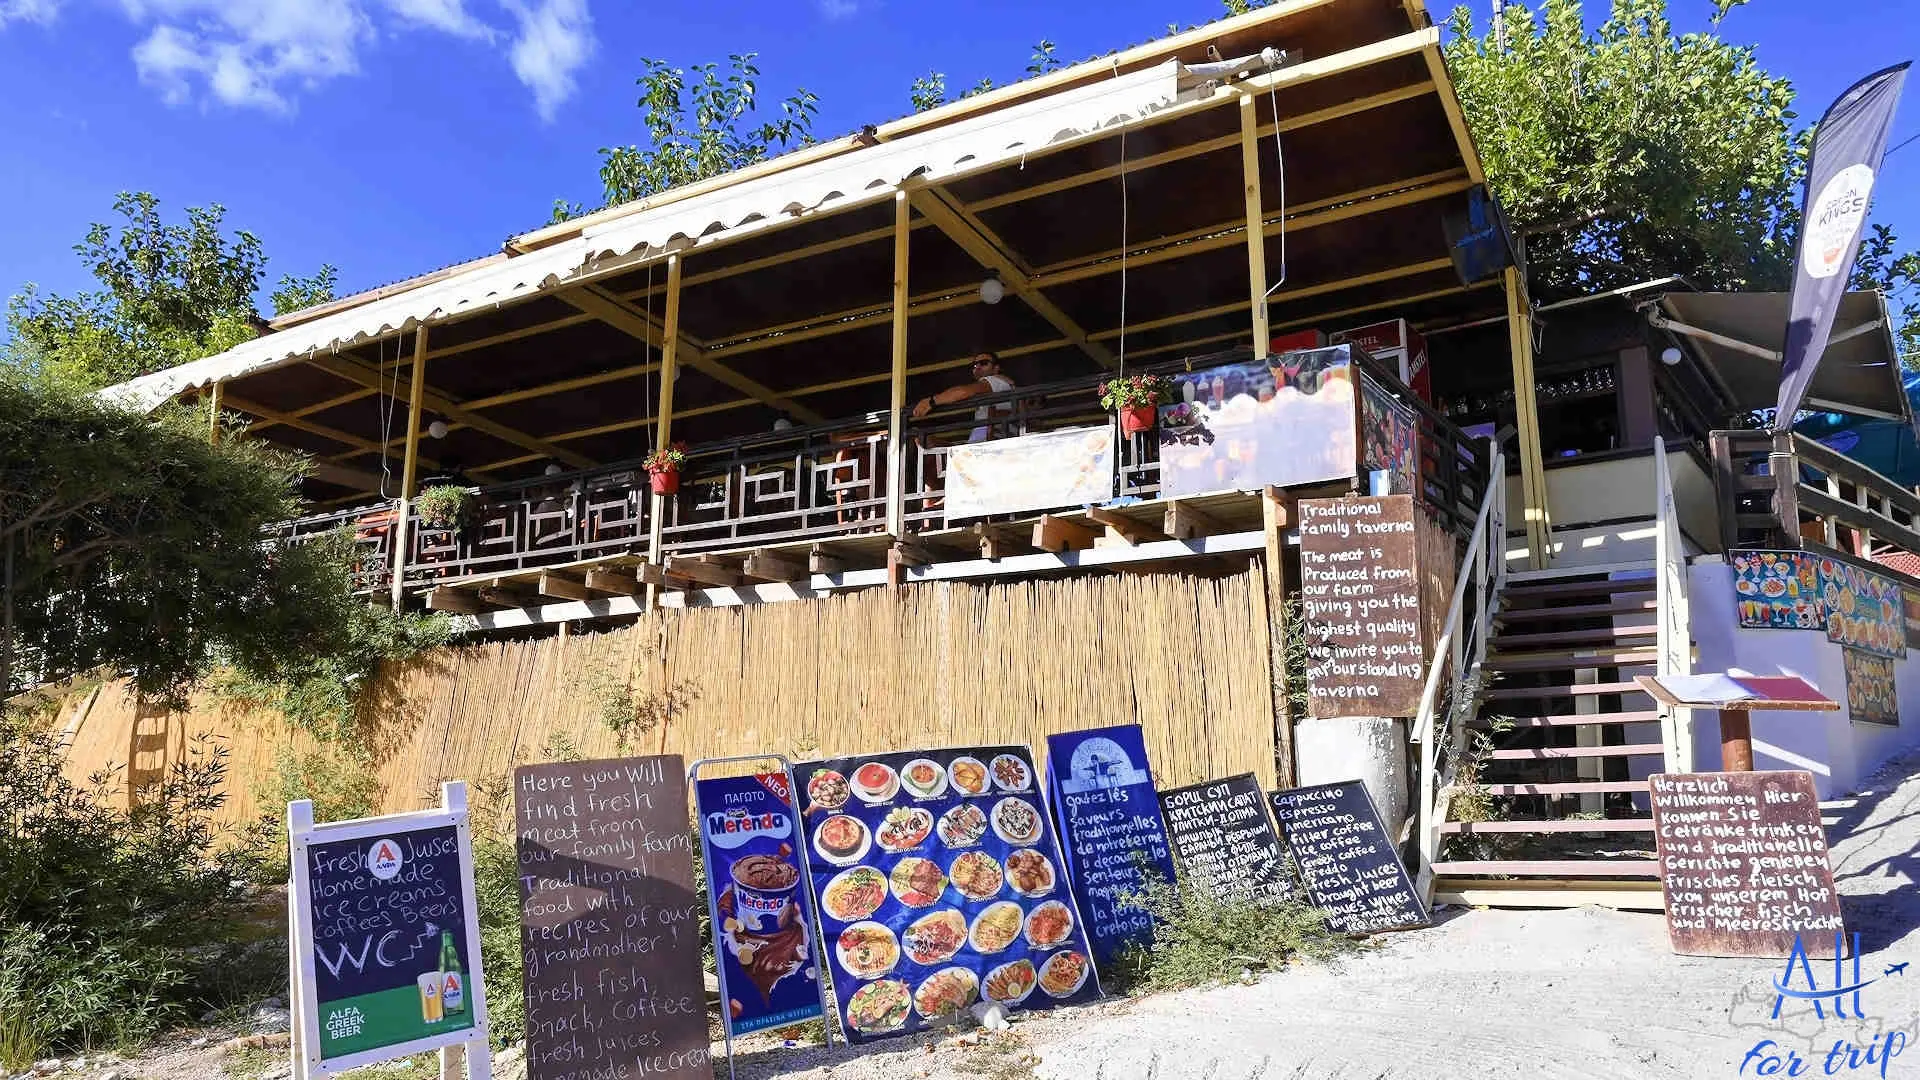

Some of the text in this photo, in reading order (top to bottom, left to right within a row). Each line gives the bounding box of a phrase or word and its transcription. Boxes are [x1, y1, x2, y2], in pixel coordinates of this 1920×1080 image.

[1302, 503, 1381, 516] Traditional
[1300, 519, 1414, 537] family taverna
[1302, 546, 1383, 562] The meat is
[1304, 583, 1373, 596] our farm
[1305, 593, 1417, 619] giving you the
[1307, 618, 1416, 641] highest quality
[1334, 642, 1377, 659] invite
[1382, 644, 1407, 660] you
[1409, 640, 1422, 656] to
[1309, 684, 1379, 697] taverna
[522, 773, 572, 792] Here
[583, 770, 619, 791] you
[1655, 776, 1728, 793] Herzlich
[724, 791, 765, 804] ΠΑΓΩΤΟ
[1764, 791, 1802, 804] Hier
[523, 795, 578, 820] find
[1727, 807, 1760, 821] Sie
[709, 812, 784, 835] Merenda
[1071, 808, 1124, 828] saveurs
[522, 818, 645, 846] meat from
[1333, 821, 1374, 836] coffee
[1748, 822, 1823, 838] trinken
[520, 831, 692, 864] our family farm
[1077, 841, 1094, 855] de
[1320, 836, 1361, 851] coffee
[1338, 845, 1377, 860] coffee
[1665, 840, 1704, 854] und
[1665, 855, 1741, 870] Gerichte
[520, 856, 647, 893] Traditional
[1316, 876, 1400, 903] Draught beer
[523, 885, 634, 918] food with
[1091, 904, 1107, 922] la
[528, 905, 697, 942] recipes of our
[1672, 917, 1706, 930] und
[314, 930, 403, 980] WC
[524, 932, 662, 977] grandmother
[526, 970, 584, 1008] fresh
[329, 1006, 360, 1019] ALFA
[326, 1014, 365, 1032] GREEK
[331, 1026, 361, 1041] BEER
[527, 1030, 662, 1068] fresh juices
